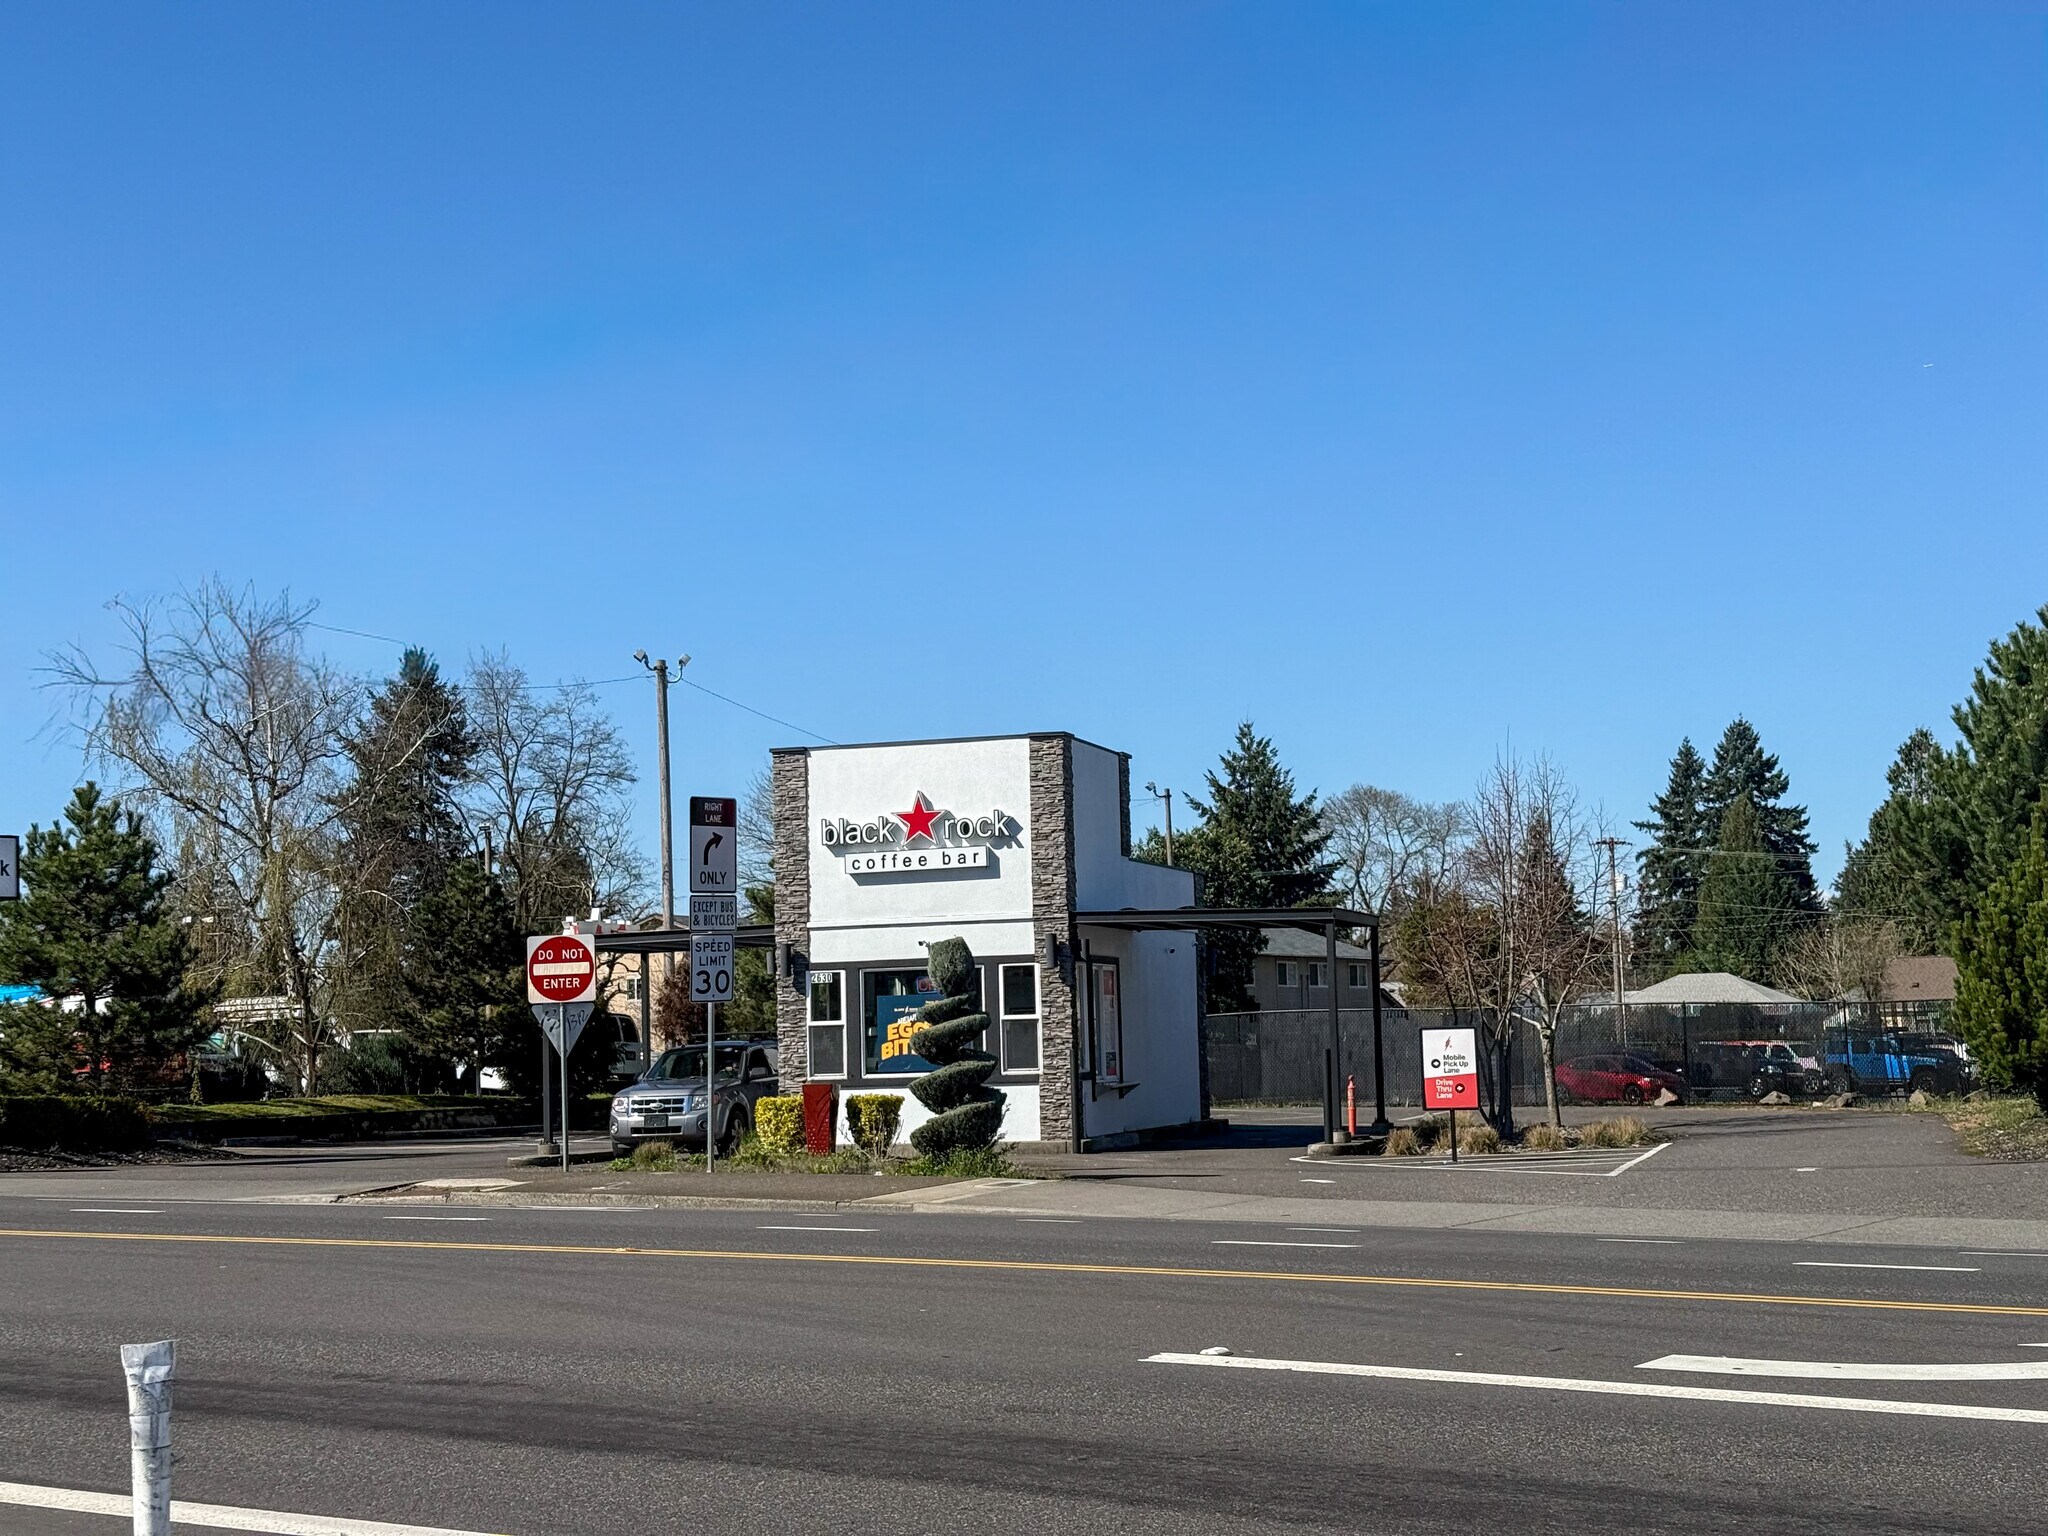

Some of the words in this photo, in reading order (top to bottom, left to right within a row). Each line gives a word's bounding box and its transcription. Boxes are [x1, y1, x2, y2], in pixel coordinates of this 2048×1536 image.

[704, 802, 723, 812] RIGHT
[705, 814, 722, 823] LANE
[821, 816, 895, 846] black
[943, 809, 1012, 840] rock
[852, 854, 928, 870] coffee
[942, 851, 979, 866] bar
[700, 871, 727, 884] ONLY
[693, 901, 717, 913] EXCEPT
[721, 901, 734, 913] BUS
[693, 914, 701, 926] &
[704, 914, 735, 926] BICYCLES
[695, 942, 731, 953] SPEED
[538, 950, 554, 961] DO
[562, 948, 585, 959] NOT
[699, 955, 727, 967] LIMIT
[543, 978, 580, 989] ENTER
[695, 969, 730, 995] 30
[811, 972, 833, 983] 2630
